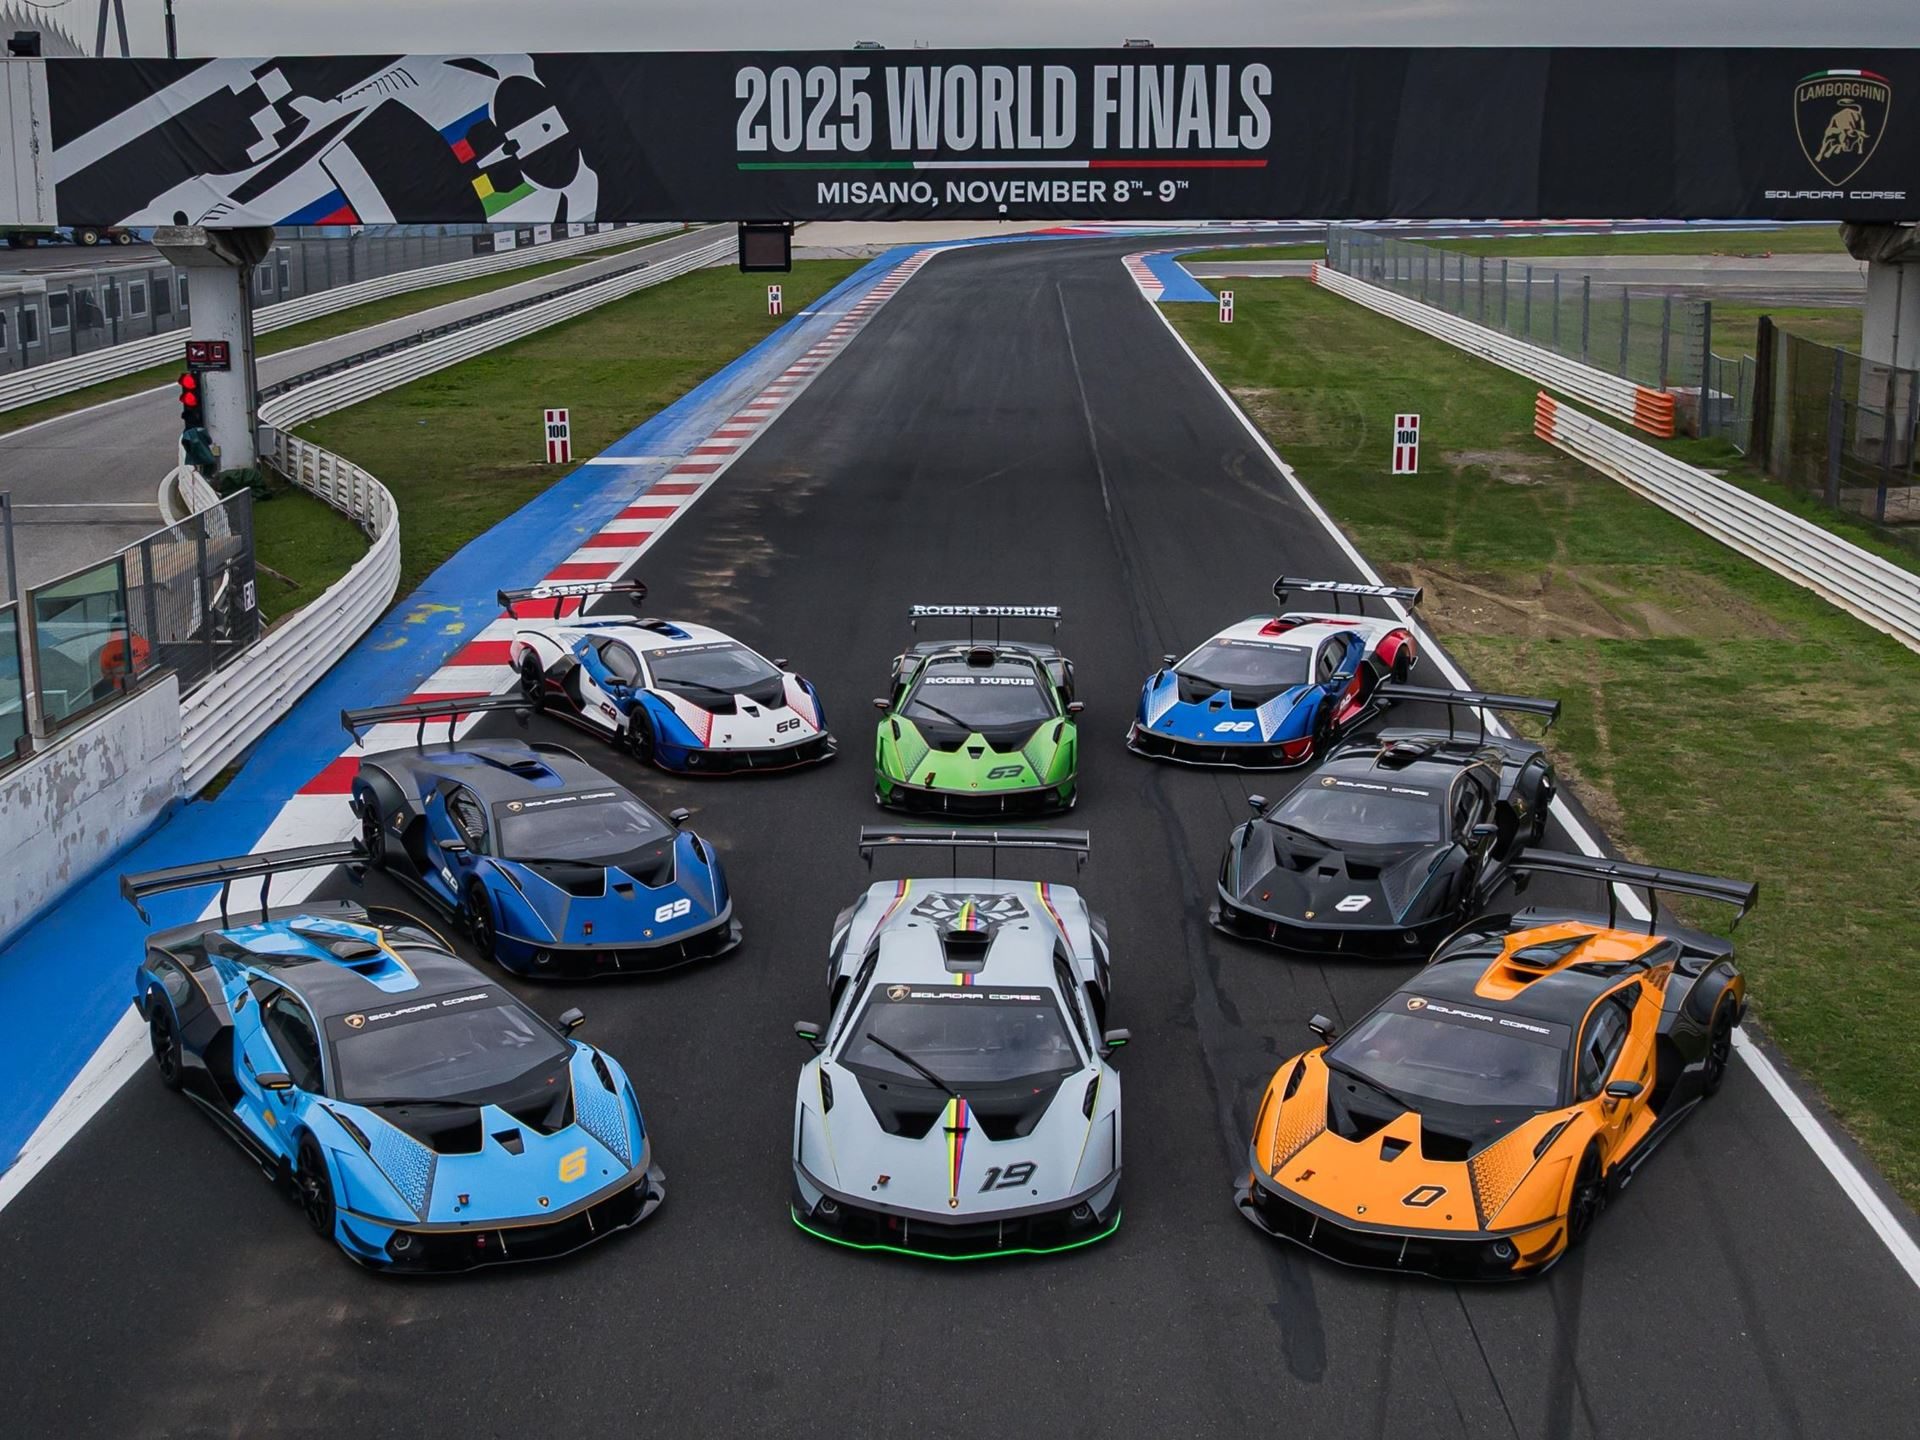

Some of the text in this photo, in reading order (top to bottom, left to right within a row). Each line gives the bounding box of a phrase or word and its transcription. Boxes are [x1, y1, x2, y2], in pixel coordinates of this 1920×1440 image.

[1800, 82, 1886, 102] LAMBORGHINI
[735, 63, 1272, 152] 2025 WORLD FINALS
[816, 181, 938, 207] MISANO,
[945, 180, 1106, 203] NOVEMBER
[1764, 190, 1906, 200] SQUADRA CORSE
[547, 424, 567, 439] 100
[1397, 430, 1417, 445] 100
[912, 604, 1058, 617] ROGER DUBUIS
[924, 677, 1035, 686] ROGER DUBUIS
[776, 717, 801, 735] 68
[986, 764, 1026, 780] 63
[654, 898, 692, 924] 69
[1334, 894, 1372, 912] 8
[910, 992, 984, 1000] SQUADRA
[367, 992, 488, 1022] SQUADRA CORSE
[1426, 1003, 1551, 1035] SQUADRA CORSE
[559, 1146, 588, 1184] 6
[977, 1162, 1038, 1194] 19
[1400, 1184, 1449, 1209] 0
